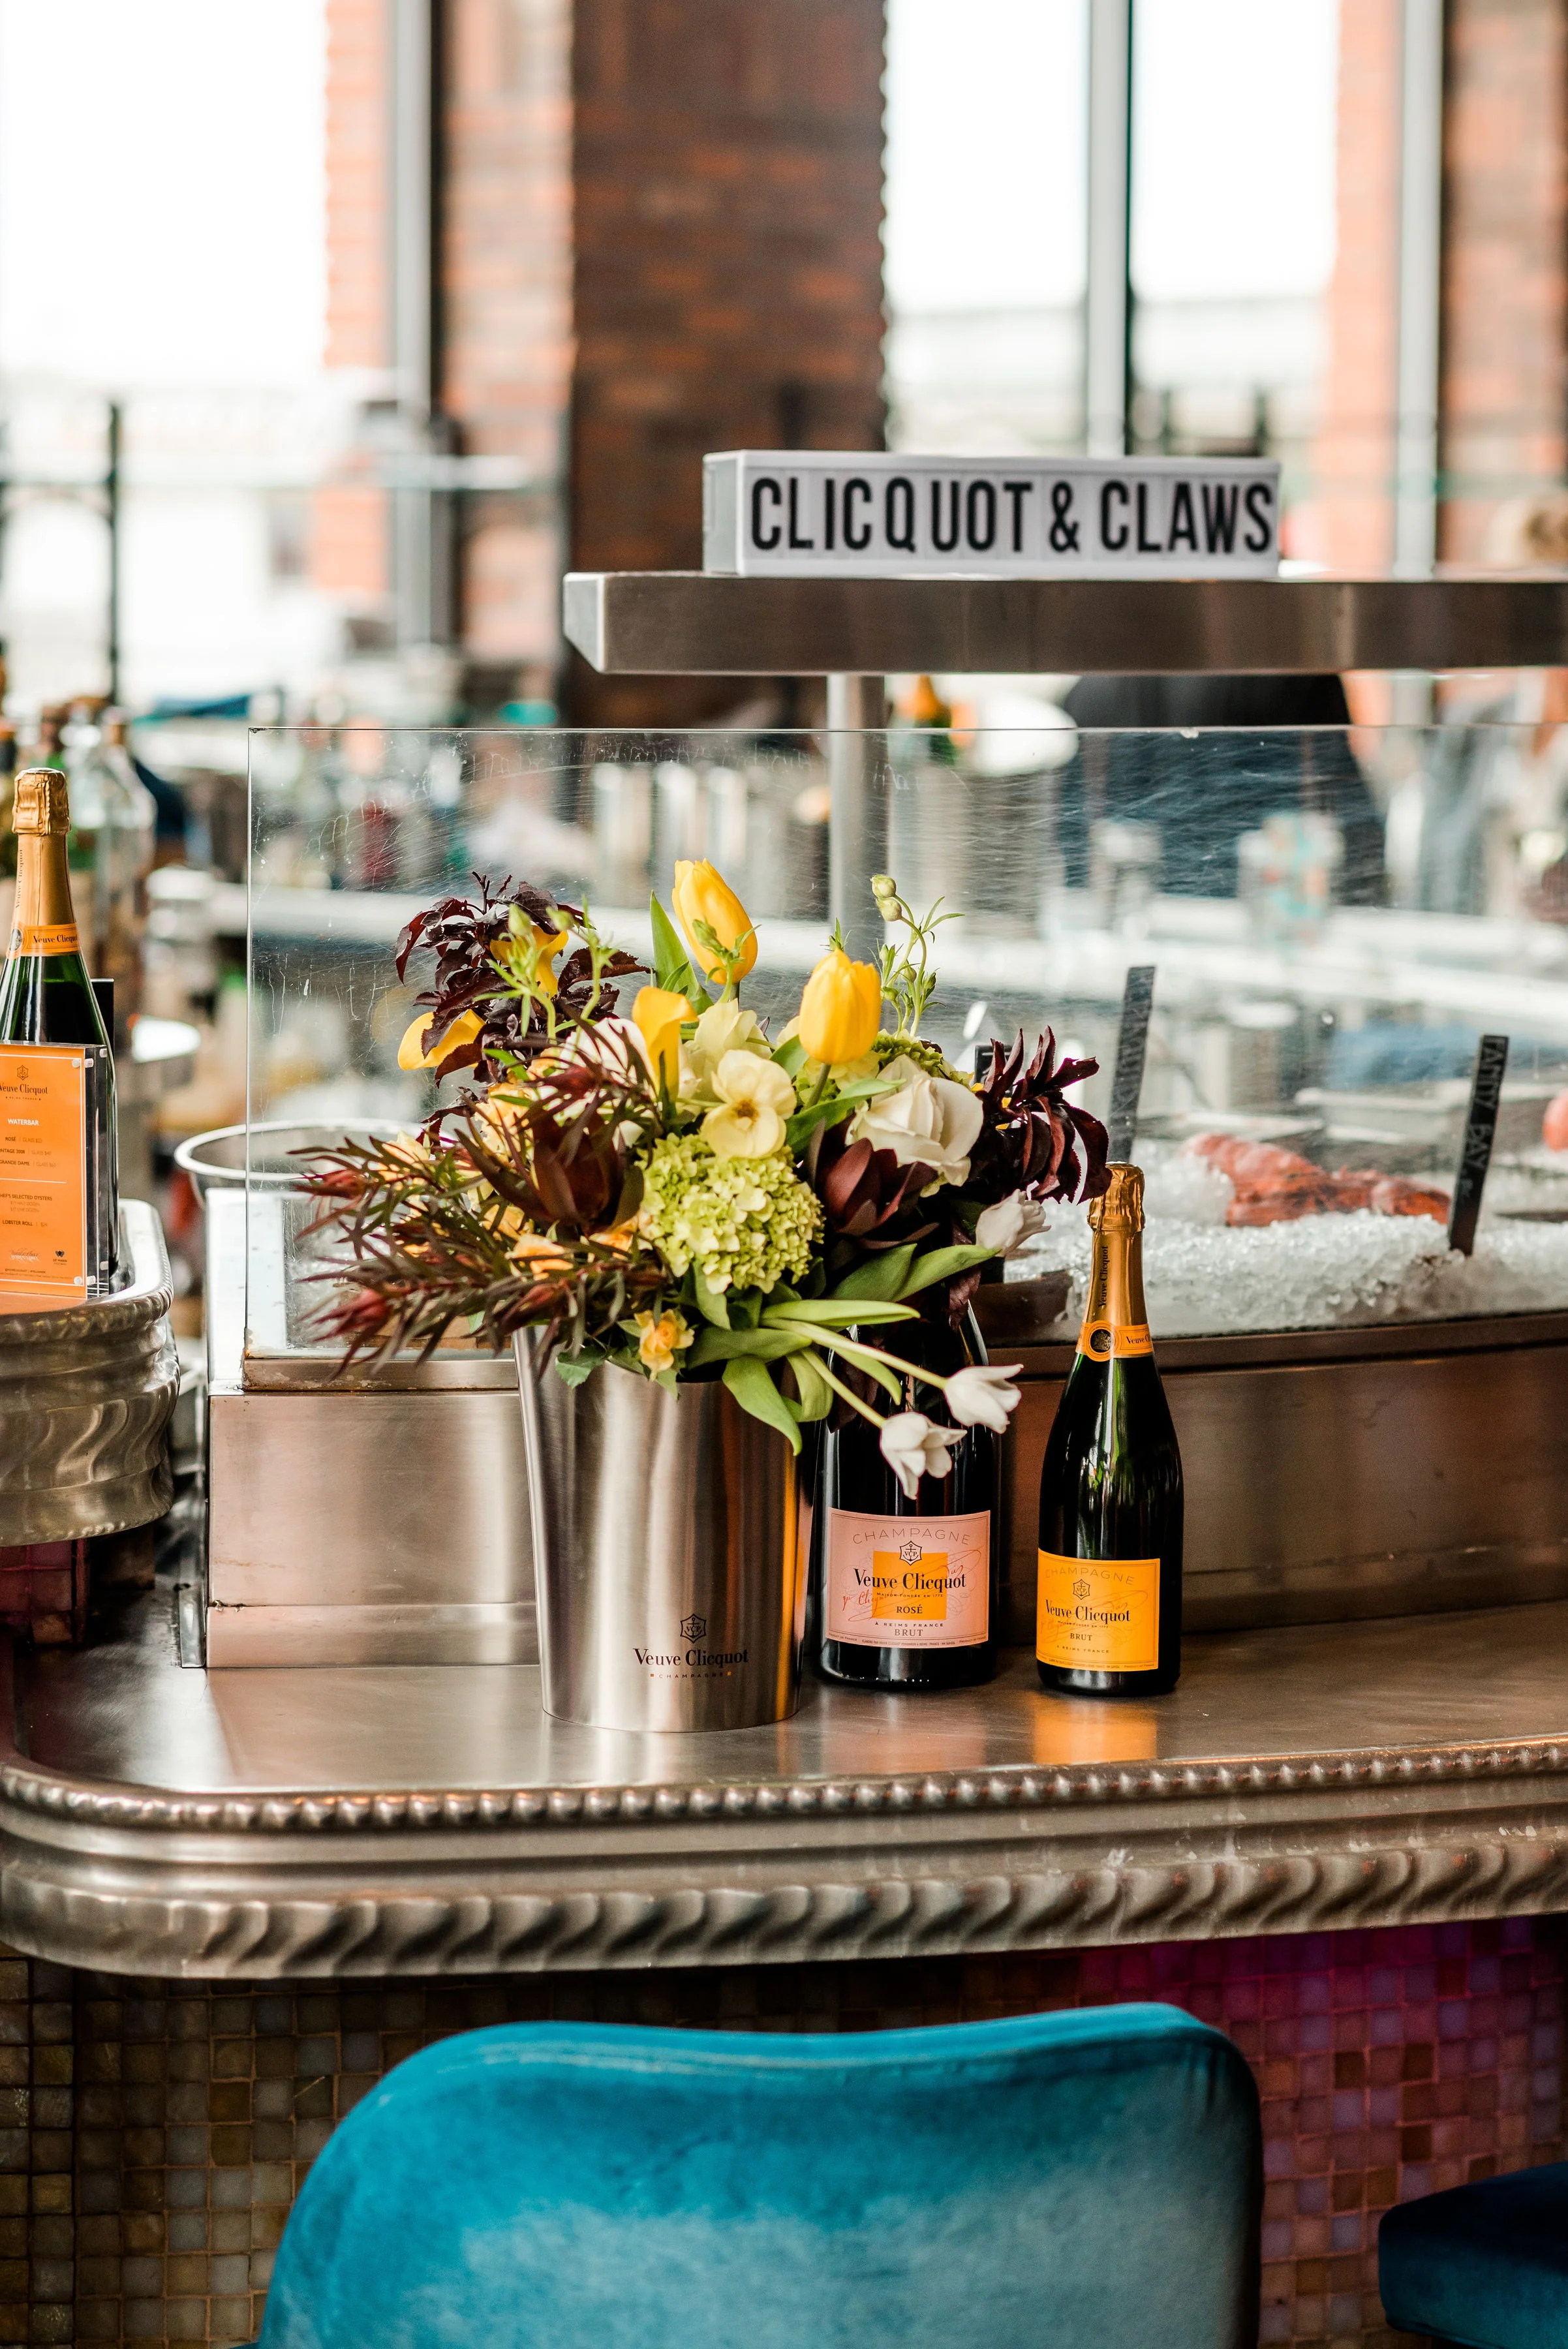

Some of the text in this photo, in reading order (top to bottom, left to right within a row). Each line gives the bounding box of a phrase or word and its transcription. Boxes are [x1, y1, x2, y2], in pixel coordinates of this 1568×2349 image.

[750, 476, 1274, 555] CLICQUOT & CLAWS
[33, 935, 55, 944] Veuve
[20, 1083, 48, 1096] Clicquot
[7, 1118, 40, 1126] WATERBAR
[1098, 1246, 1110, 1308] Veuve Clicquot
[1126, 1336, 1145, 1344] Veuve
[852, 1528, 971, 1545] CHAMPAGNE
[853, 1568, 966, 1593] Veuve Clicquot
[1045, 1567, 1135, 1586] CHAMPAGNE
[896, 1604, 923, 1614] ROSÉ
[1045, 1599, 1072, 1618] Veuve
[1075, 1605, 1131, 1625] Clicquot
[894, 1628, 924, 1637] BRUT
[1069, 1633, 1093, 1641] BRUT
[632, 1648, 749, 1668] Veuve Clicquot
